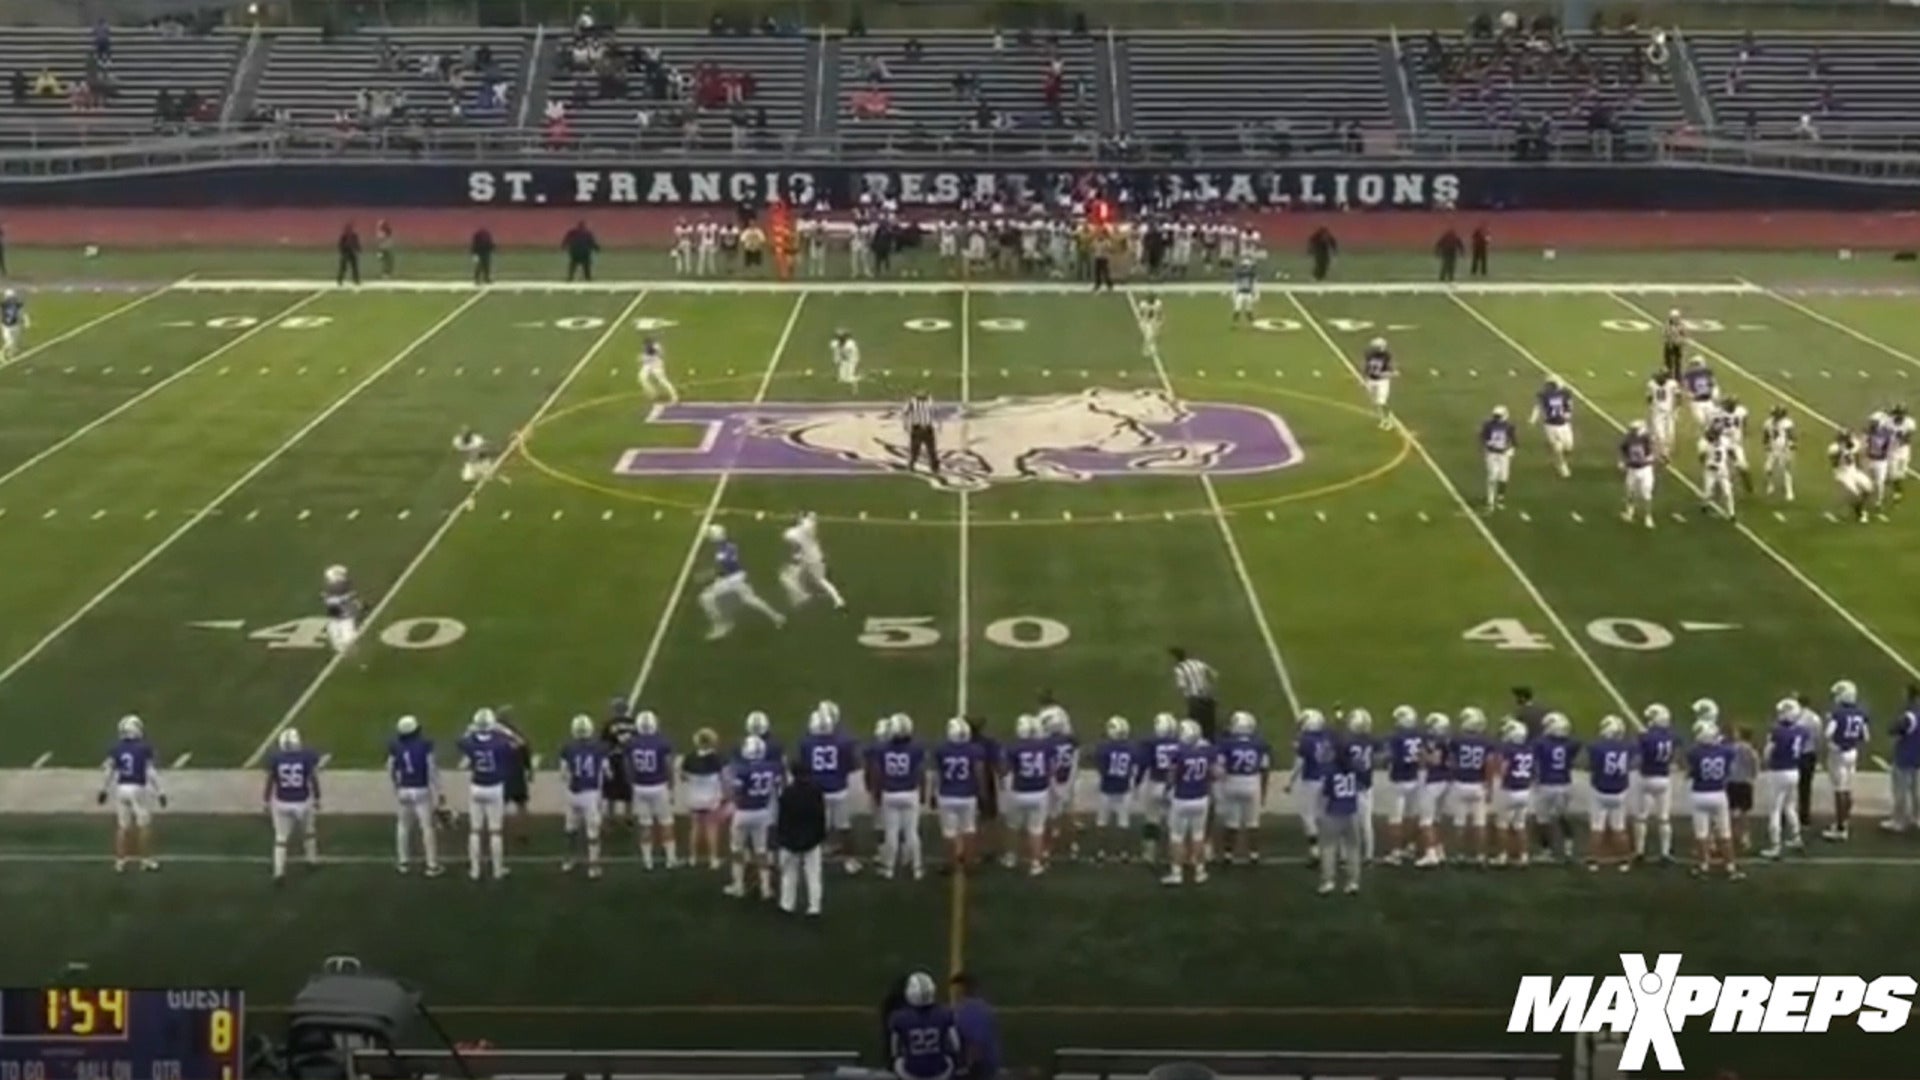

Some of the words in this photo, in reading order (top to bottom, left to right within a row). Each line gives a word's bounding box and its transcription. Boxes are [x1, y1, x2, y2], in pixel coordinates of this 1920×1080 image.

[469, 171, 547, 202] ST.
[119, 752, 135, 776] 3
[402, 750, 414, 774] 1
[574, 754, 596, 779] 14
[811, 745, 838, 771] 63
[943, 756, 970, 781] 73
[1019, 751, 1046, 777] 54
[1183, 757, 1209, 782] 70
[1551, 746, 1566, 770] 9
[1604, 751, 1628, 776] 64
[277, 762, 304, 788] 56
[1333, 772, 1357, 799] 20
[210, 1009, 233, 1053] 8
[909, 1027, 941, 1056] 22
